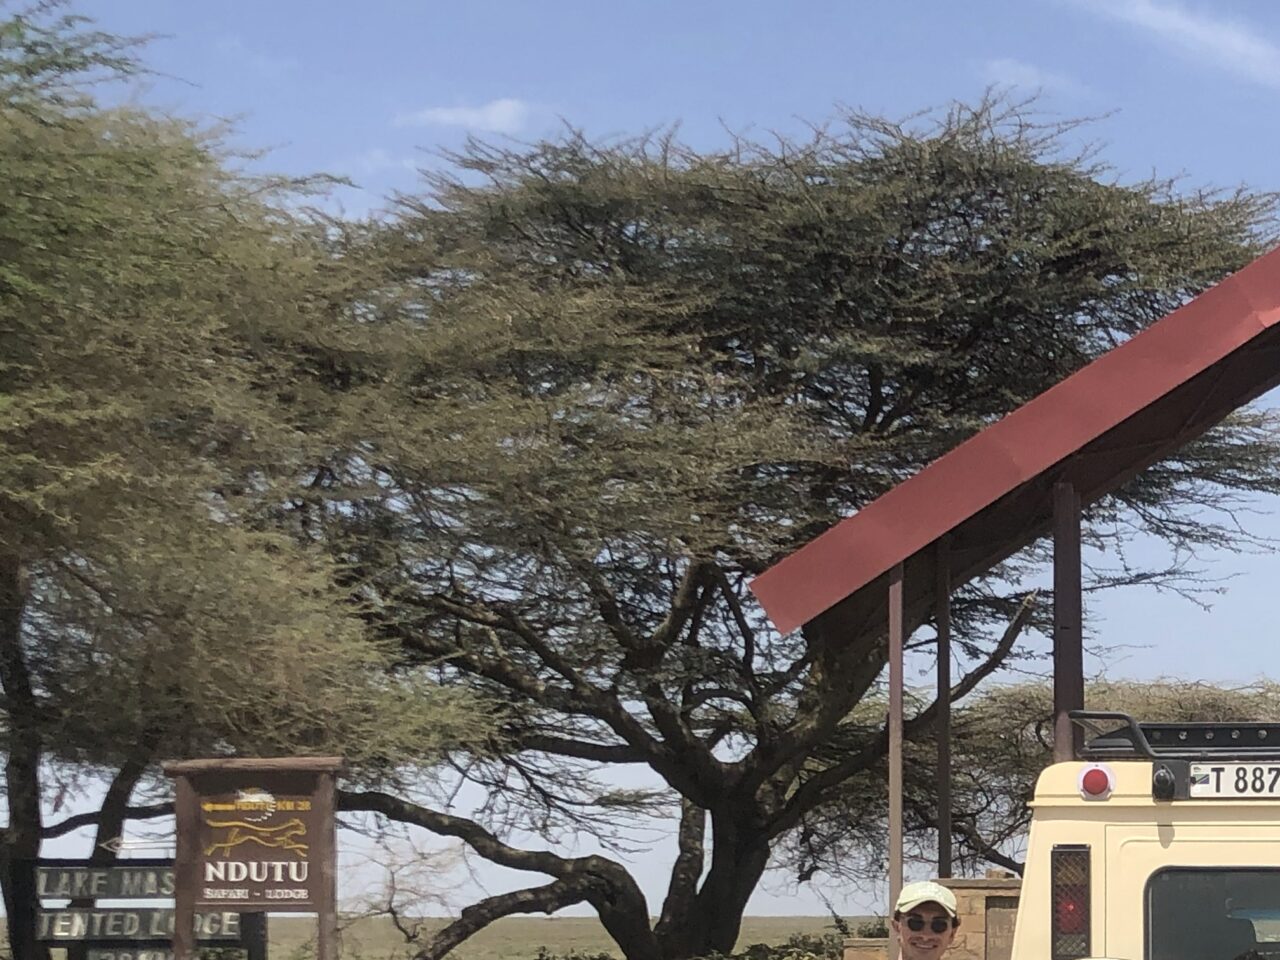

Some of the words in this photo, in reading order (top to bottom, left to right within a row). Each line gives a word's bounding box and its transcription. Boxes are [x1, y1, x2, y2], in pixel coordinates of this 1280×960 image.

[1211, 767, 1225, 793] T
[37, 872, 108, 896] LAKE
[120, 871, 175, 896] MAS
[204, 861, 309, 882] NDUTU
[203, 887, 249, 899] SAFARI
[265, 888, 309, 899] LODGE
[40, 912, 140, 937] TENTED
